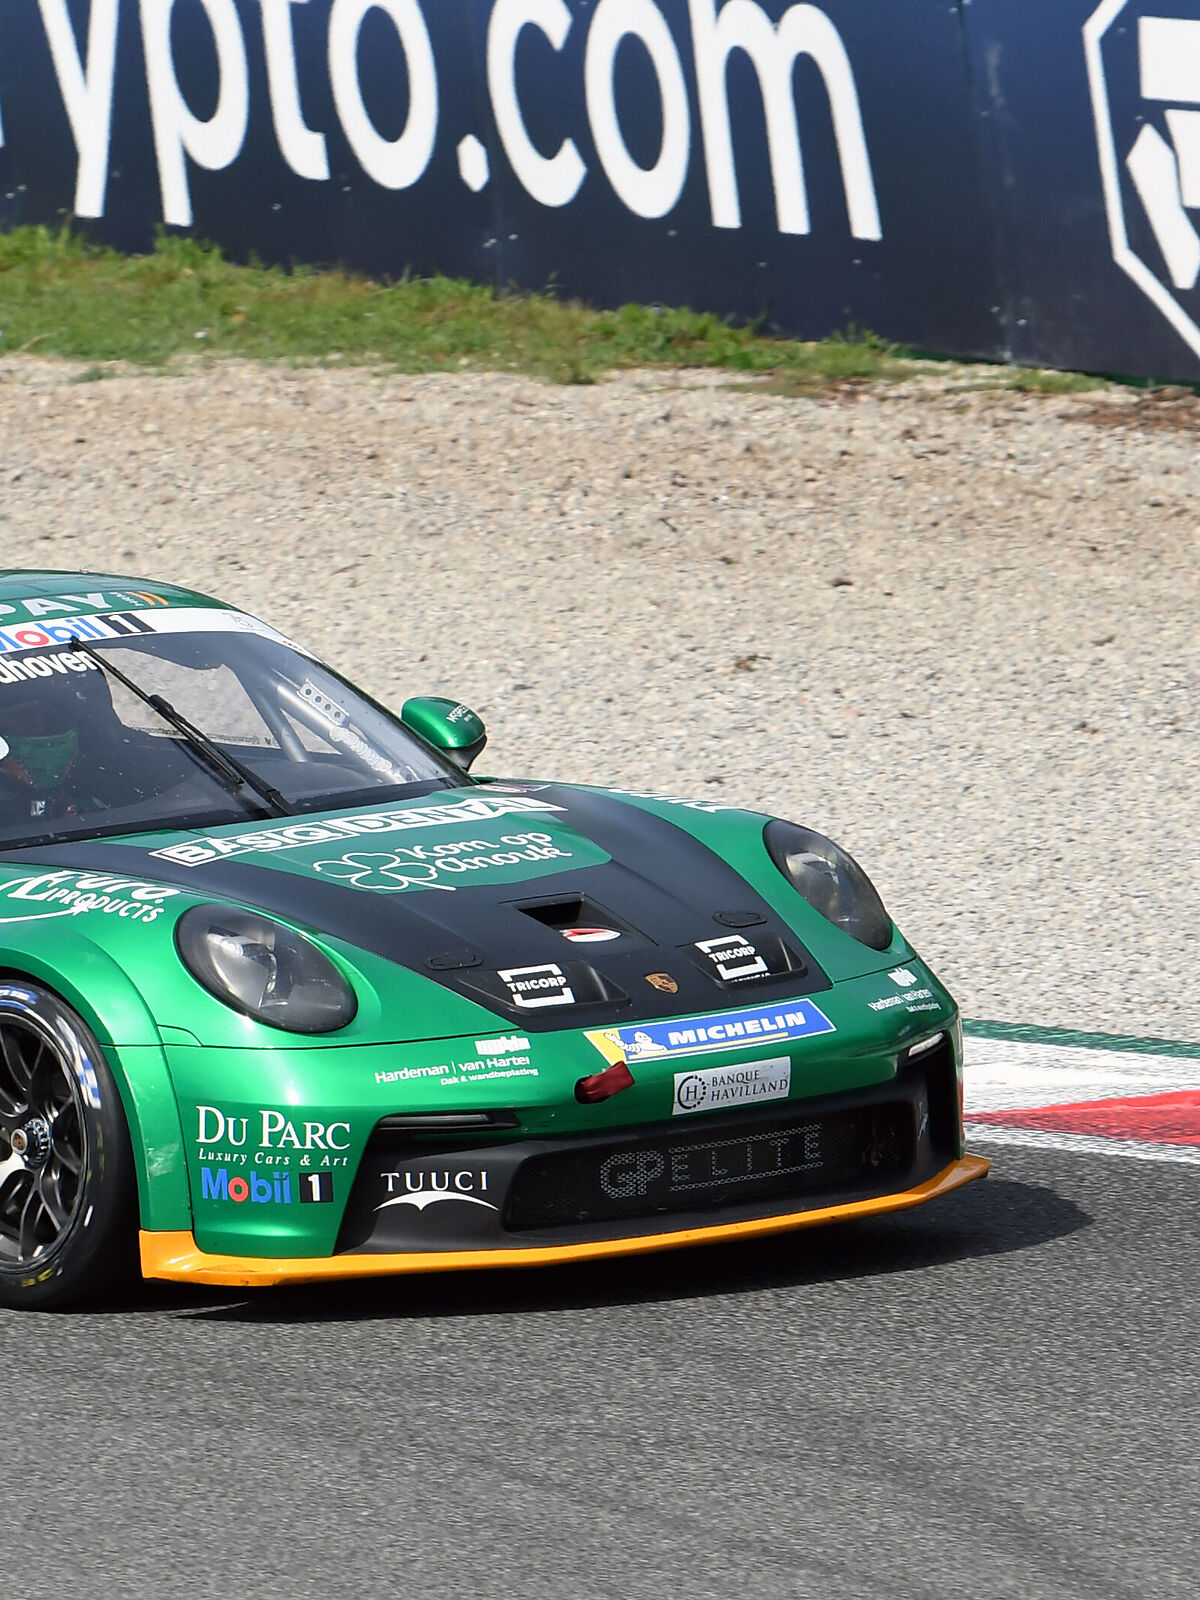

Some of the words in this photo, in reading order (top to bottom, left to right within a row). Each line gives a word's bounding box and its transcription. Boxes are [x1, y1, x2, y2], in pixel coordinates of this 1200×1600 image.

[108, 613, 143, 636] 1
[170, 824, 347, 863] BASIQ
[341, 799, 552, 833] DENTAL
[395, 838, 501, 861] Kom
[708, 946, 756, 963] TRICORP
[507, 976, 567, 993] TRICORP
[668, 1012, 806, 1046] MICHELIN
[375, 1064, 450, 1084] Hardeman
[458, 1060, 486, 1072] van
[711, 1070, 760, 1087] BANQUE
[711, 1079, 788, 1101] HAVILLAND
[199, 1148, 247, 1165] Luxury
[254, 1152, 291, 1166] Cars
[300, 1155, 312, 1167] &
[321, 1154, 349, 1167] Art
[201, 1166, 292, 1205] Mobil
[308, 1173, 322, 1202] 1
[380, 1171, 488, 1192] TUUCI
